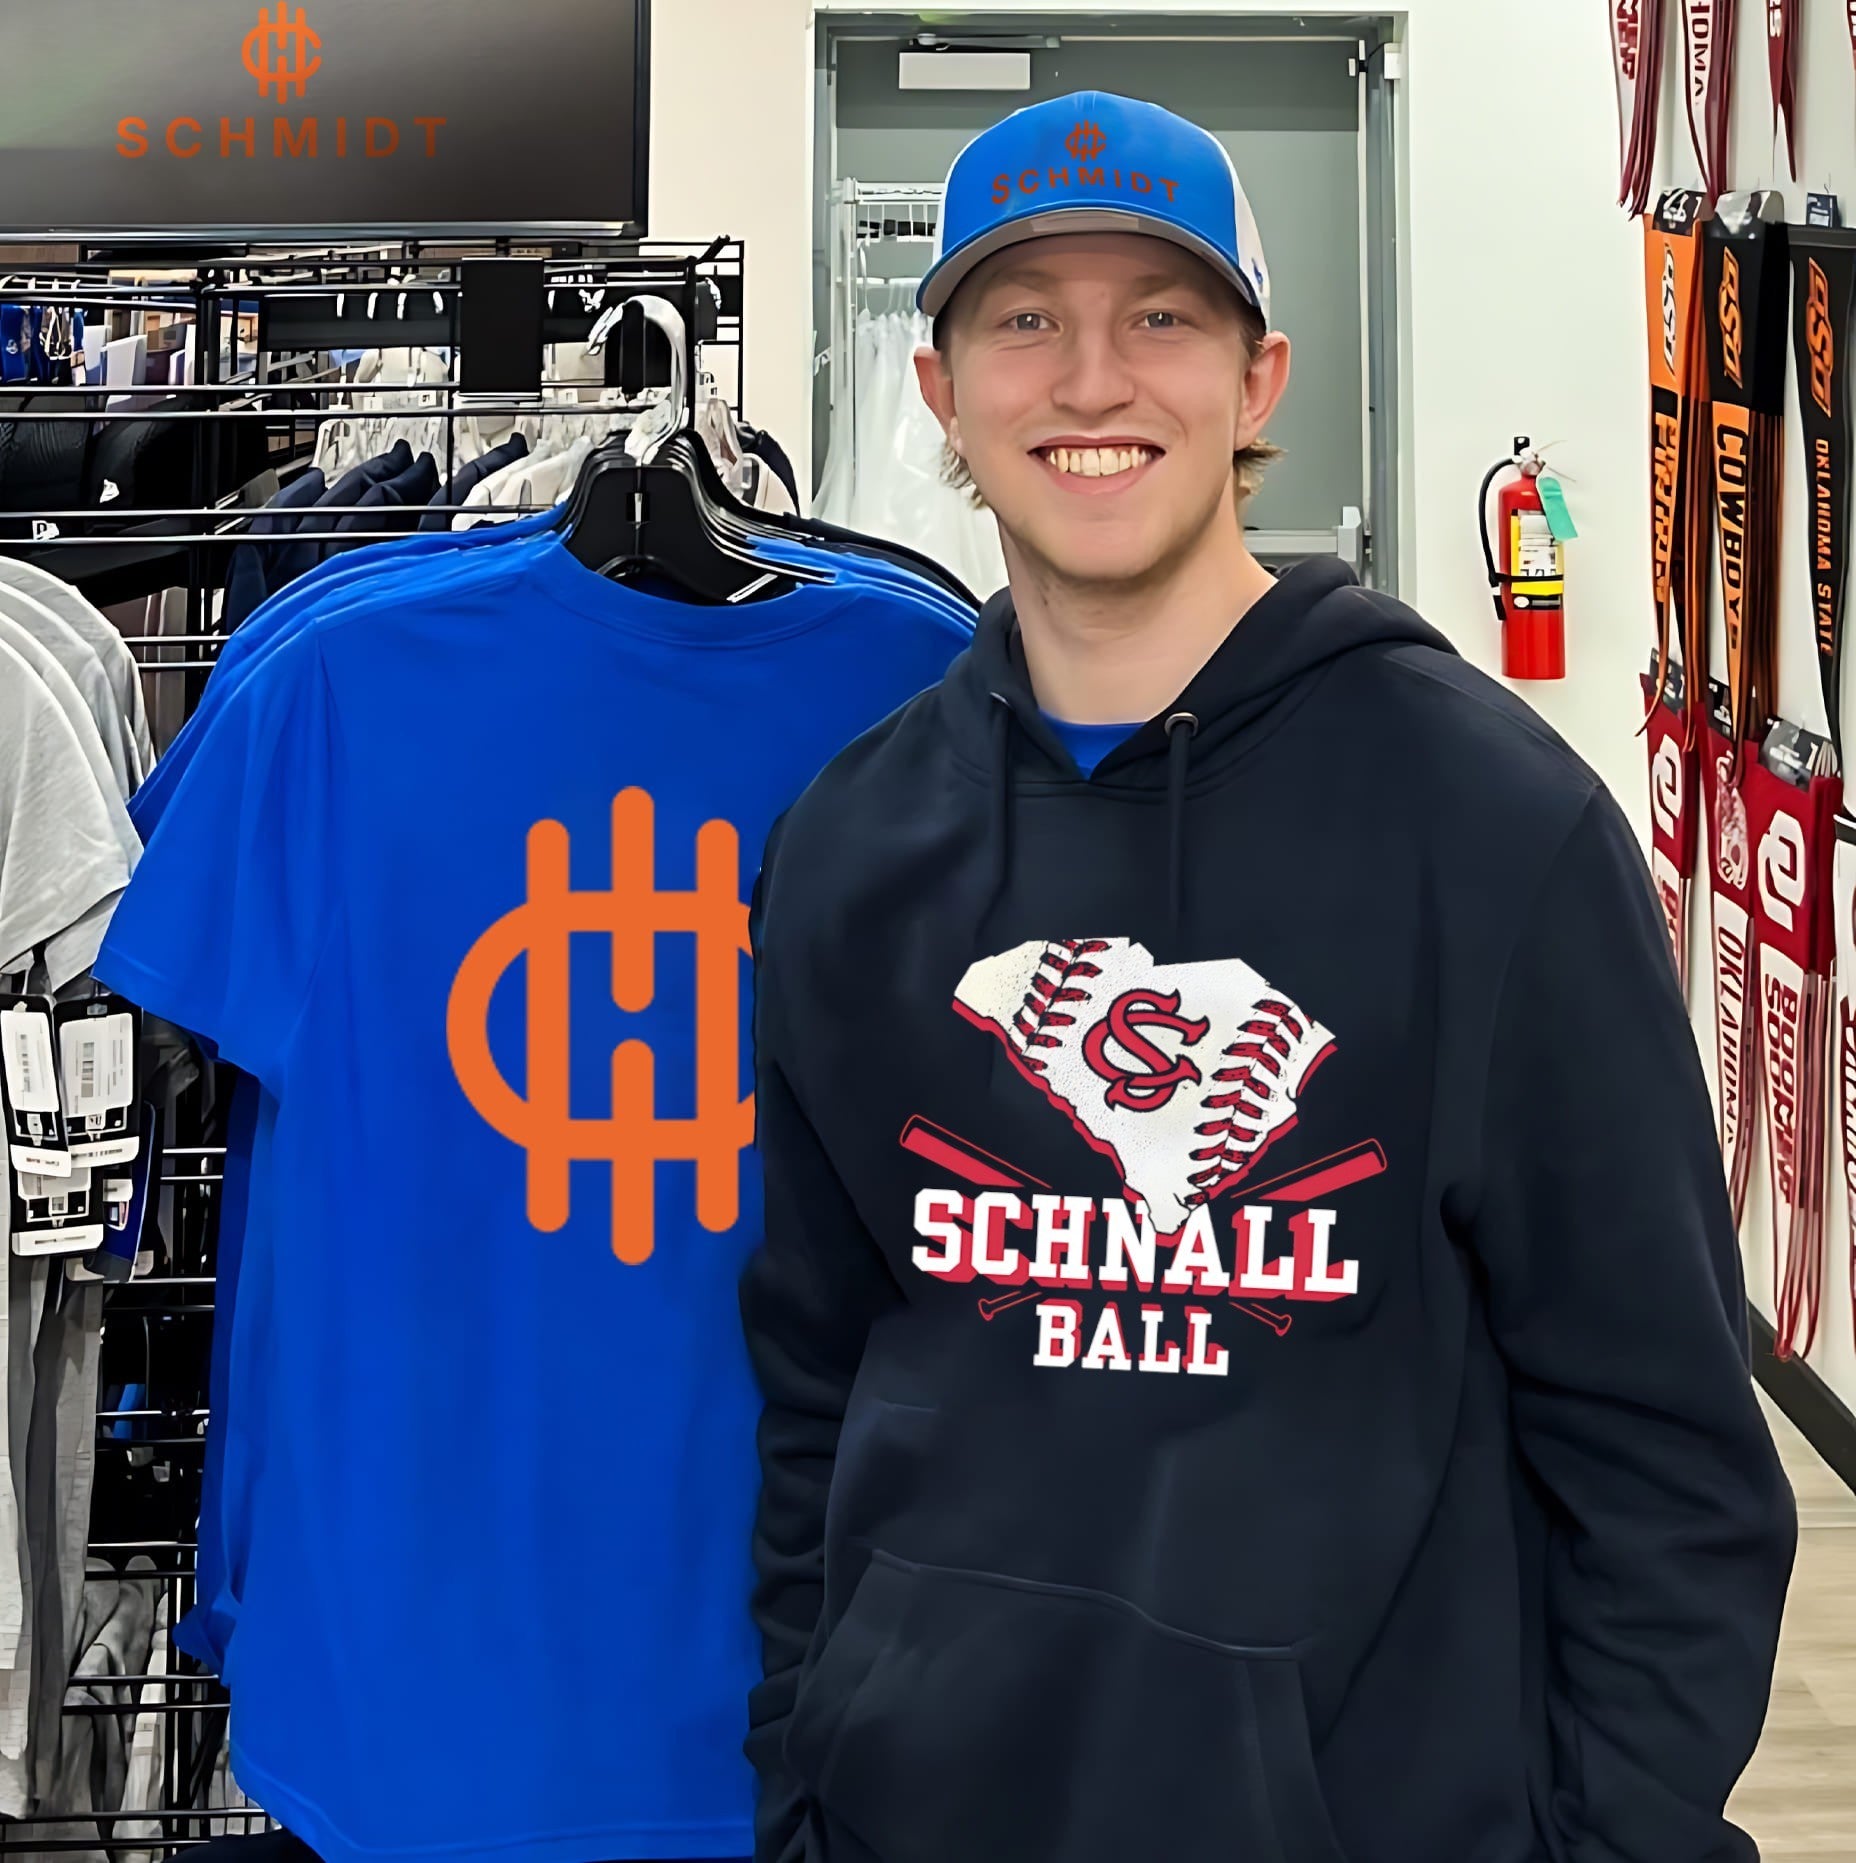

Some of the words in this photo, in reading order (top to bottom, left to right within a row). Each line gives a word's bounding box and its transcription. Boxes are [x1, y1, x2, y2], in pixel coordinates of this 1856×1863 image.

[116, 117, 447, 158] SCHMIDT
[991, 166, 1179, 205] SCHMIDT
[1815, 438, 1832, 570] OKLAHOMA
[912, 1188, 1360, 1298] SCHNALL
[1033, 1302, 1230, 1377] BALL
